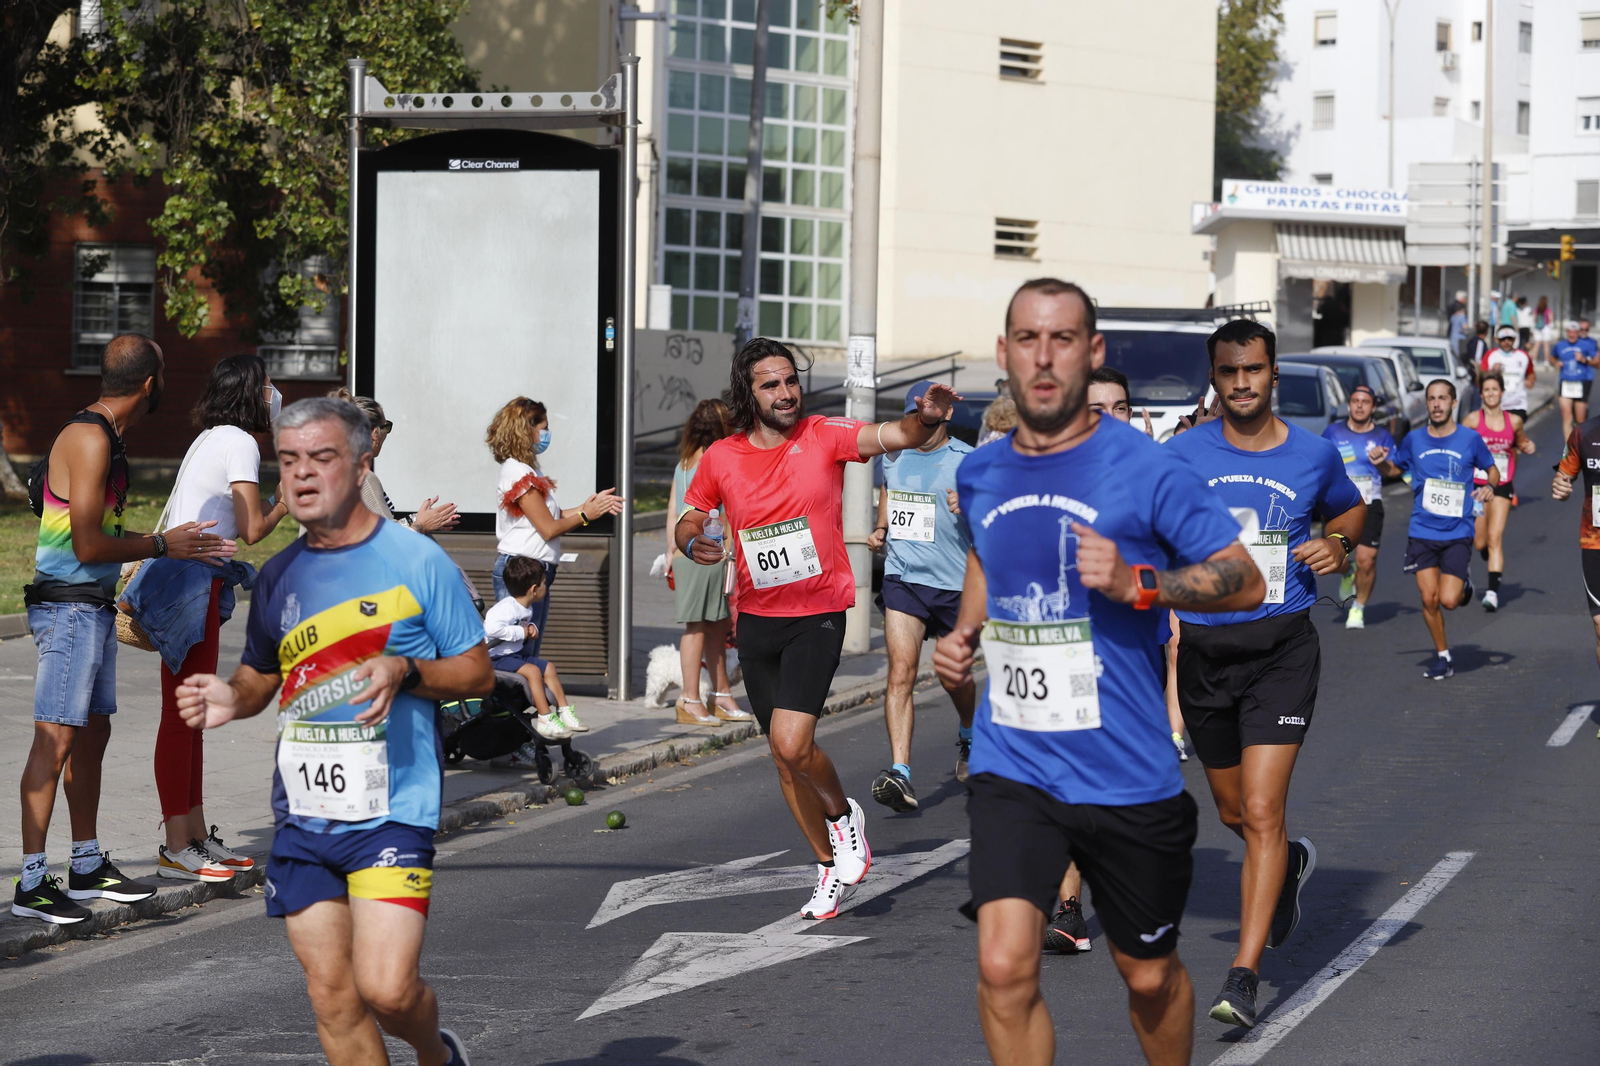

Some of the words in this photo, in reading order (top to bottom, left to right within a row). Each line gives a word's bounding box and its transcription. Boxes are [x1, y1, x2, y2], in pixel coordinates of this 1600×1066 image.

[462, 160, 483, 169] Clear
[485, 160, 519, 169] Channel
[1245, 185, 1321, 197] CHURROS
[1266, 198, 1340, 211] PATATAS
[1345, 203, 1401, 213] FRITAS
[1219, 474, 1254, 484] VUELTA
[1255, 476, 1263, 484] A
[1264, 478, 1297, 501] HUELVA
[913, 495, 932, 503] HUELVA
[1431, 493, 1450, 506] 565
[997, 494, 1040, 515] VUELTA
[1040, 494, 1051, 507] A
[1051, 494, 1099, 524] HUELVA
[891, 510, 915, 527] 267
[751, 529, 774, 540] VUELTA
[775, 527, 780, 535] A
[780, 521, 805, 533] HUELVA
[1256, 534, 1282, 544] HUELVA
[757, 547, 790, 572] 601
[1028, 628, 1037, 644] A
[1038, 626, 1082, 644] HUELVA
[1003, 664, 1048, 700] 203
[296, 727, 327, 741] VUELTA
[328, 728, 337, 742] A
[338, 726, 376, 742] HUELVA
[299, 762, 346, 793] 146
